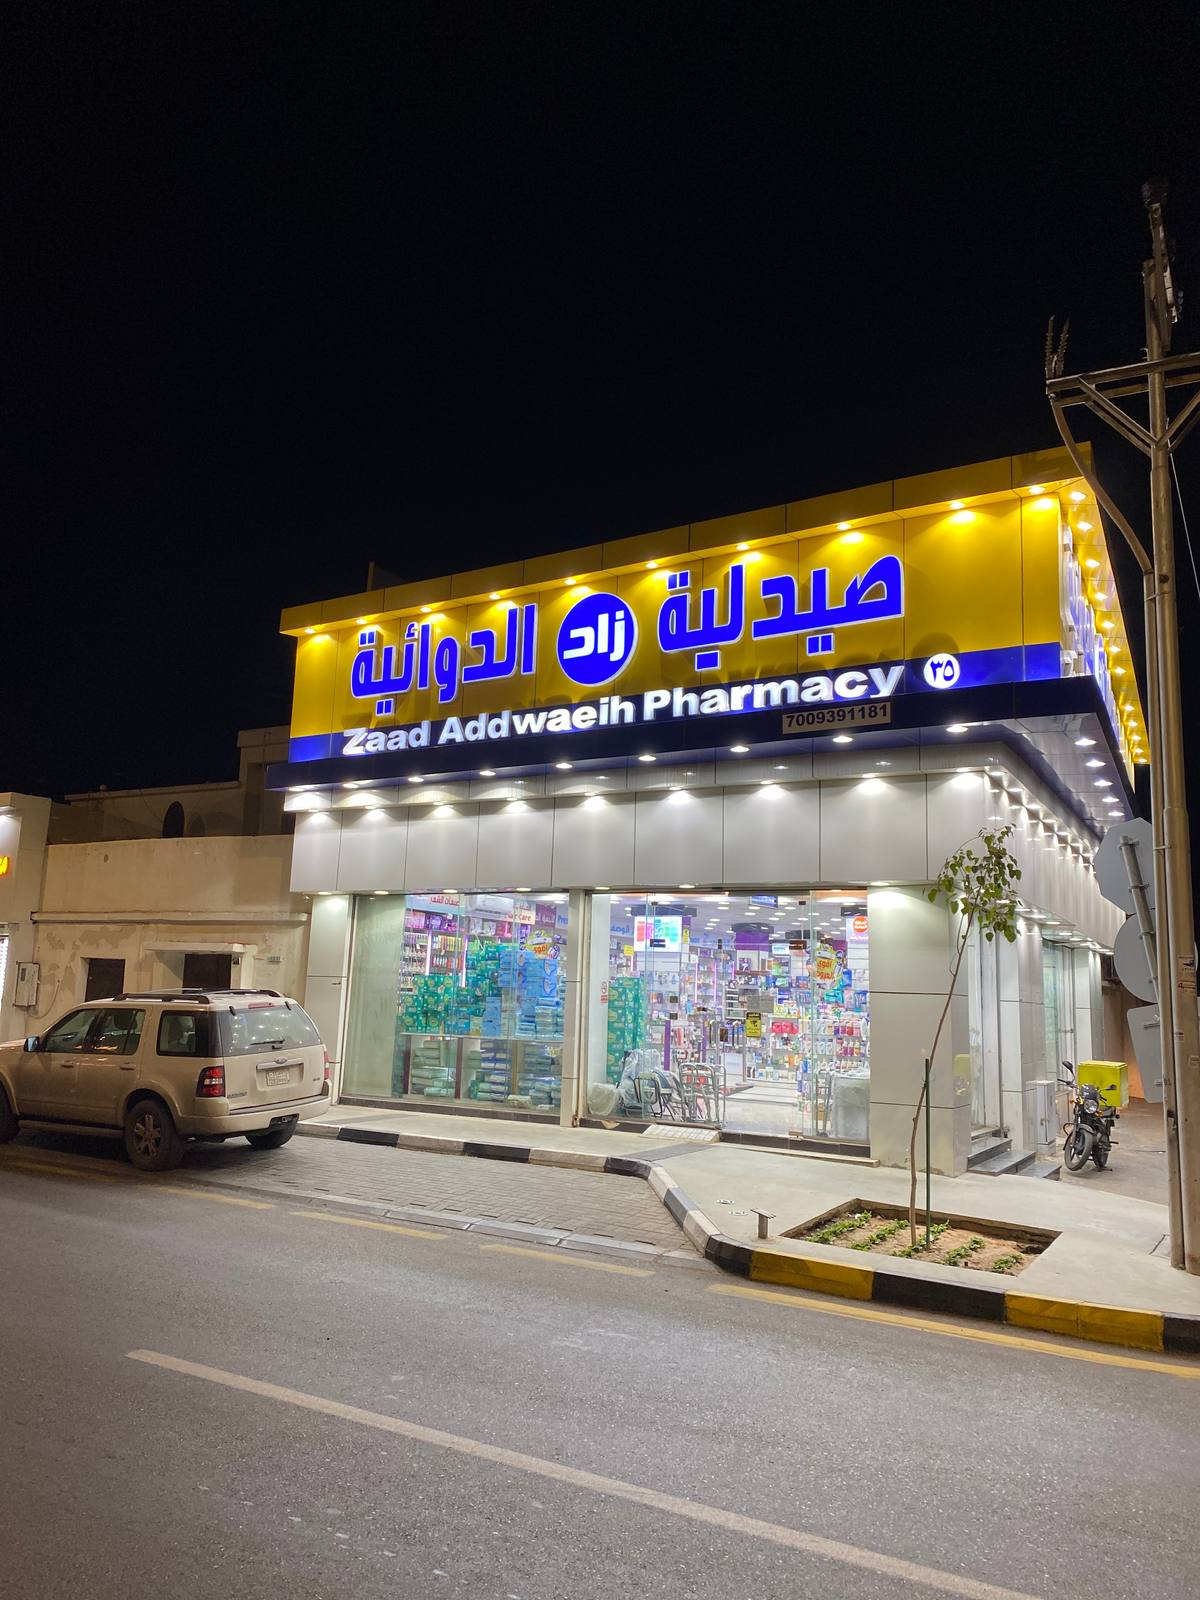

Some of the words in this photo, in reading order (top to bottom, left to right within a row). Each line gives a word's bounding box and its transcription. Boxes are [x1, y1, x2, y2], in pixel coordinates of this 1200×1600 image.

[563, 610, 626, 662] زاد
[657, 554, 905, 672] صيدلية
[350, 603, 538, 717] الدوائية
[930, 660, 955, 682] ٣٥
[342, 720, 431, 757] Zaad
[437, 695, 636, 743] Addwaeih
[643, 664, 904, 722] Pharmacy
[786, 703, 887, 728] 7009391181
